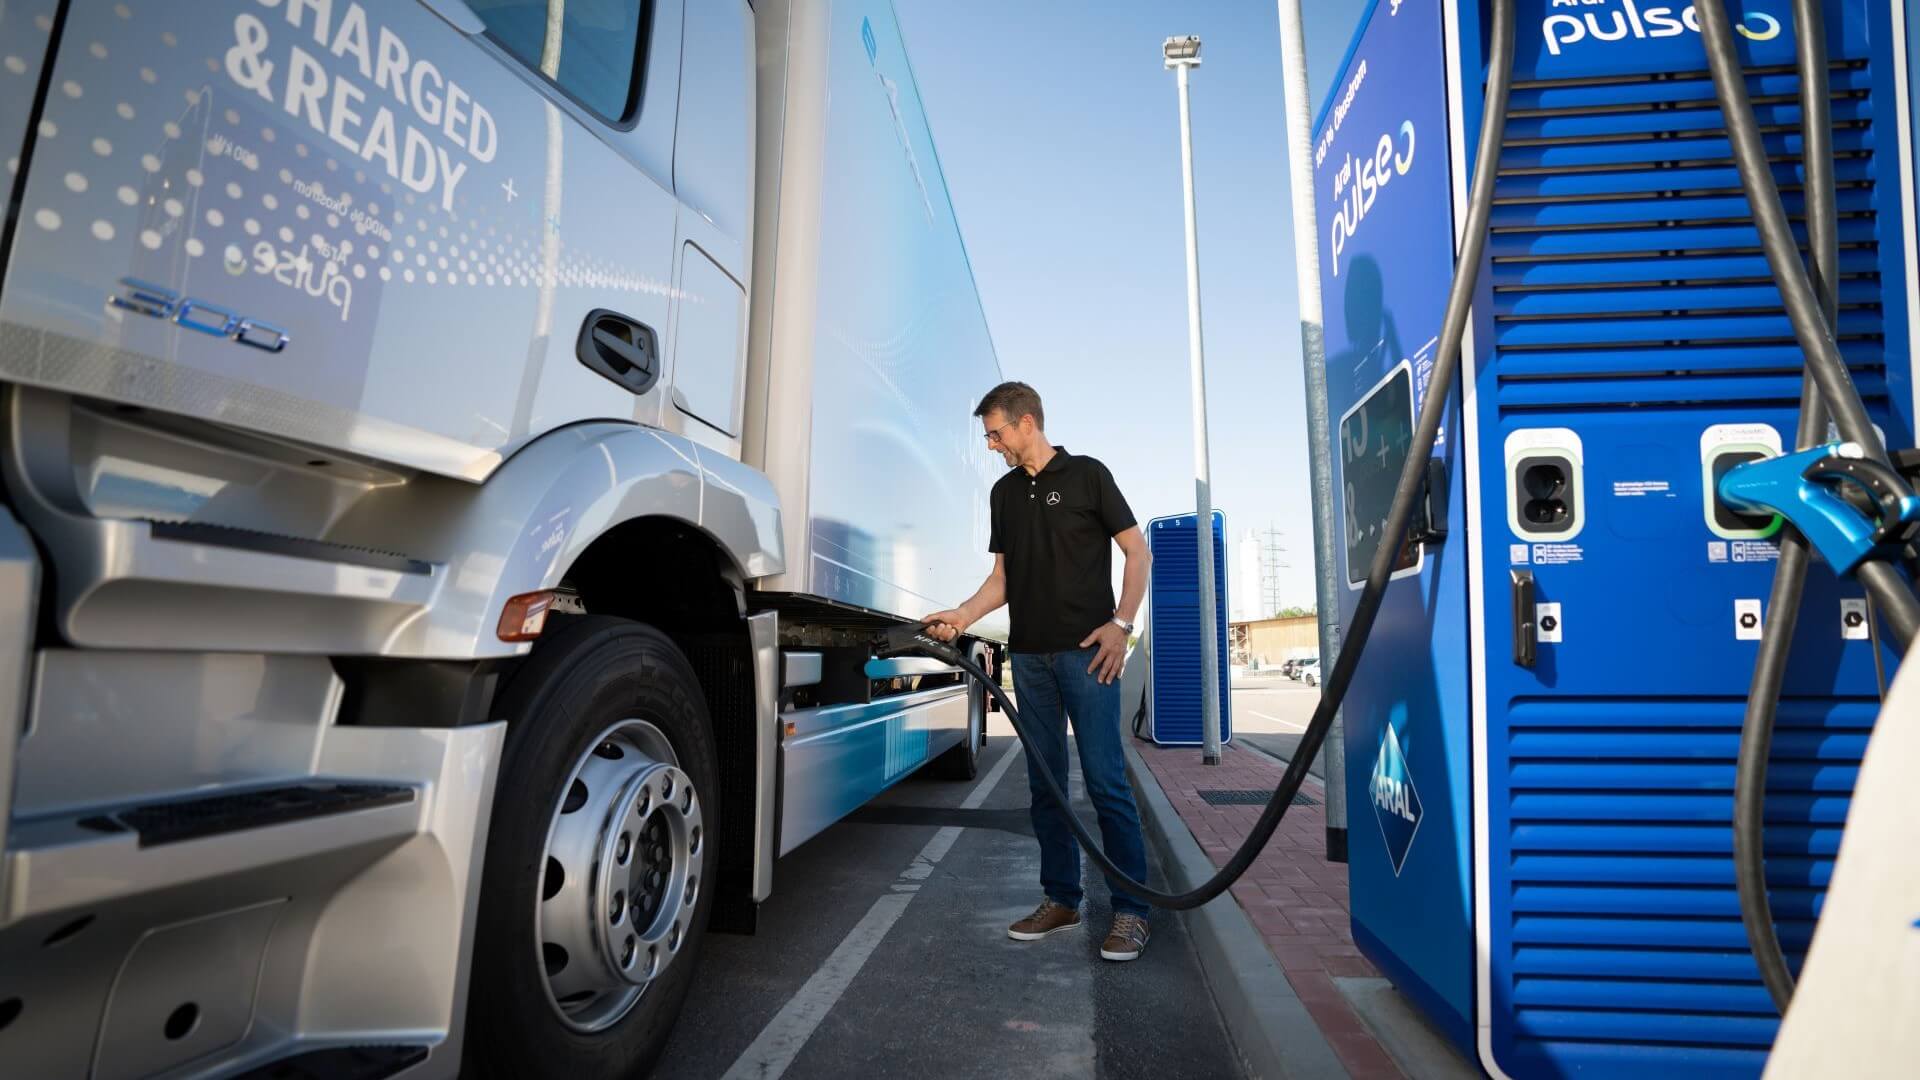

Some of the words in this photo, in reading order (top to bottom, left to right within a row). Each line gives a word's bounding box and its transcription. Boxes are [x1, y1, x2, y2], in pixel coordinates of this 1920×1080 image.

[224, 13, 275, 103] &
[283, 45, 467, 212] READY
[255, 0, 498, 164] HARGED
[1316, 139, 1327, 169] 100
[1326, 124, 1334, 148] %
[1334, 59, 1367, 131] Ökostrom
[1331, 133, 1394, 278] pulse
[1334, 151, 1351, 202] Aral
[1375, 775, 1416, 823] ARAL
